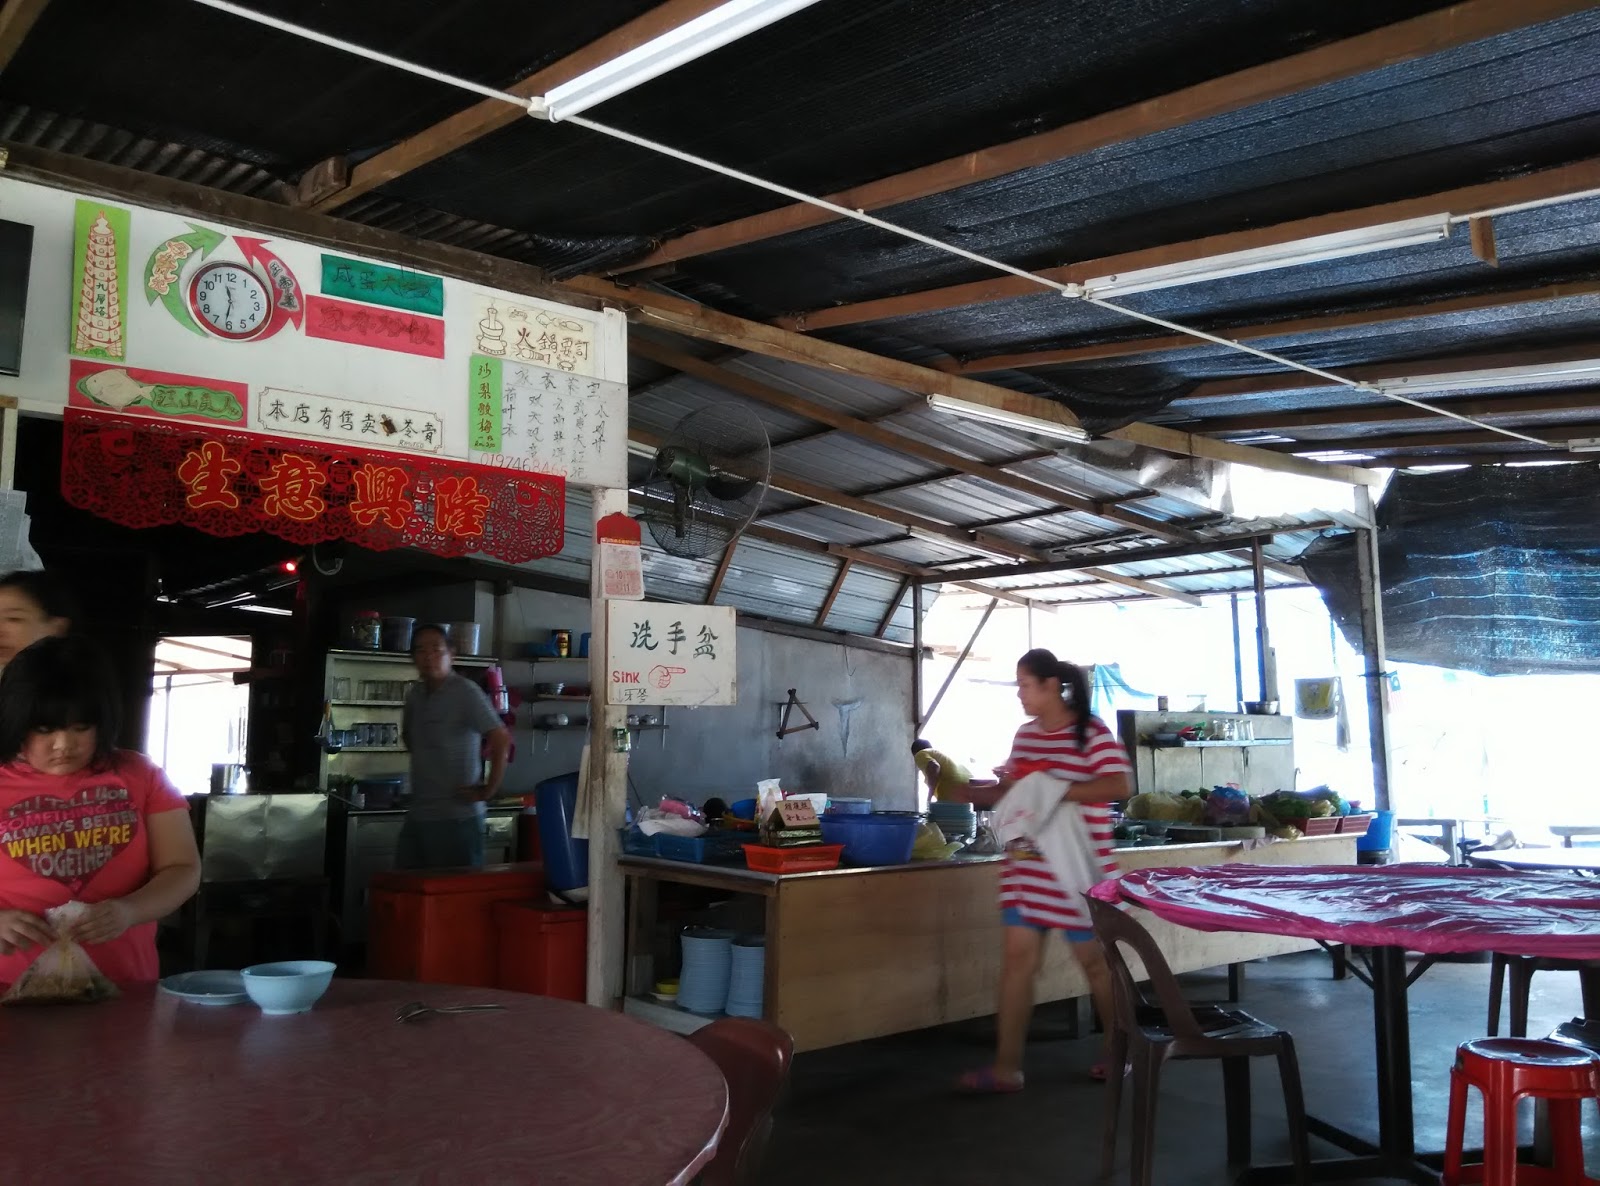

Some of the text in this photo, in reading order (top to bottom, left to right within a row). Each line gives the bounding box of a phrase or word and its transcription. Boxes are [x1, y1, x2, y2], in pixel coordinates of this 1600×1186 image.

[213, 273, 222, 283] 11
[226, 273, 237, 283] 12
[204, 280, 215, 291] 10
[243, 279, 247, 288] 1
[199, 291, 207, 301] 9
[250, 290, 257, 299] 2
[203, 304, 210, 314] 8
[254, 302, 260, 311] 3
[213, 314, 220, 324] 7
[249, 313, 256, 322] 4
[226, 321, 232, 330] 6
[240, 319, 247, 329] 5
[178, 441, 490, 536] 生意興隆
[630, 620, 718, 660] 洗手盆
[1, 810, 137, 844] ALWAYS BETTER
[8, 824, 130, 858] WHEN WE'RE
[29, 844, 113, 876] TOGETHER
